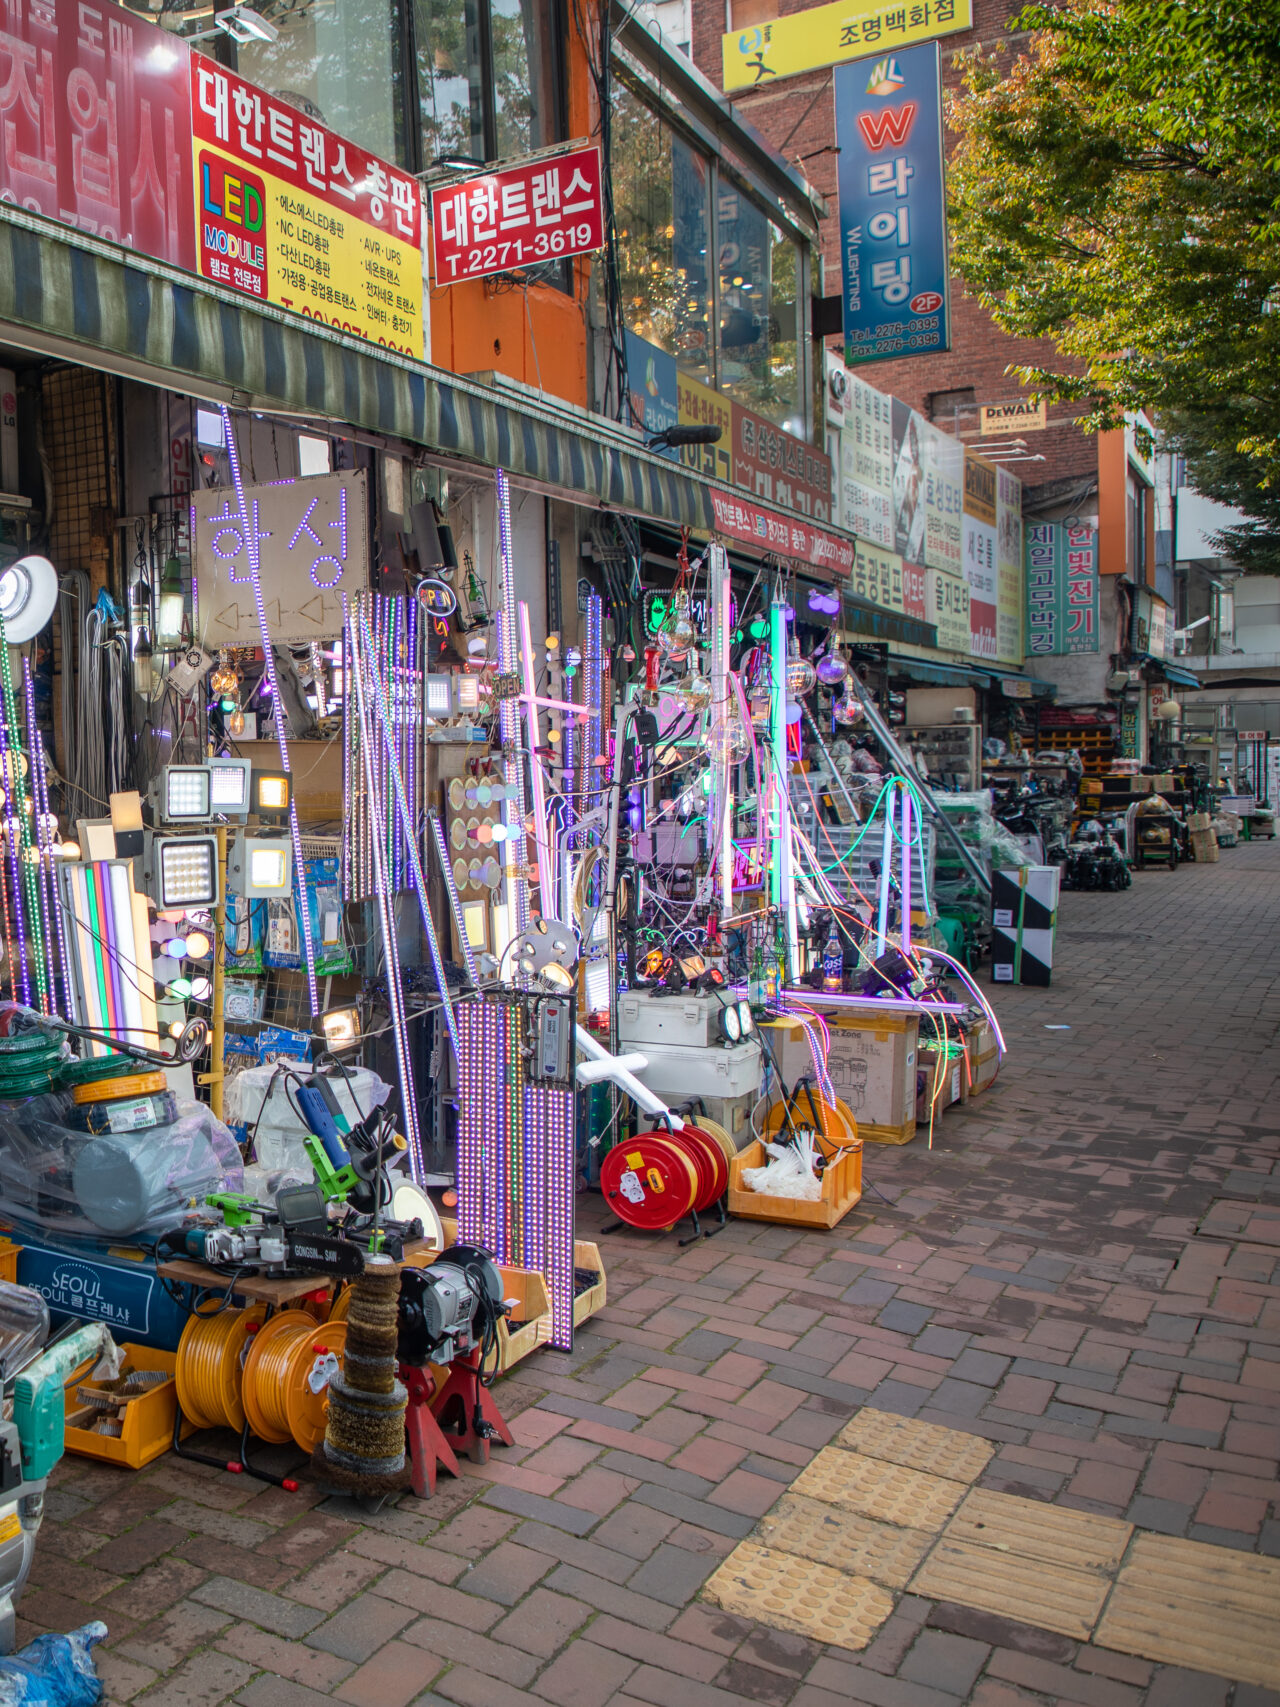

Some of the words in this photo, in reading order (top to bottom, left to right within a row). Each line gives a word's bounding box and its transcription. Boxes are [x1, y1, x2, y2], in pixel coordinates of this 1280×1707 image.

[839, 0, 955, 47] 조명백화점
[859, 104, 914, 147] W
[197, 66, 356, 202] 대한트랜스
[366, 160, 417, 238] 총판
[203, 162, 264, 233] LED
[440, 167, 595, 248] 대한트랜스
[205, 224, 265, 271] MODULE
[281, 220, 294, 237] NC
[297, 227, 329, 255] LED총판
[447, 222, 593, 275] T.2271-3619
[868, 157, 914, 305] 라이팅
[210, 257, 230, 280] 램프
[234, 266, 261, 294] 전문점
[280, 244, 330, 278] 다산LED총판
[365, 261, 401, 287] 네온트랜스
[847, 246, 861, 312] LIGHTING
[366, 282, 394, 306] 전자네온
[396, 293, 416, 315] 트랜스
[916, 296, 937, 312] 2F
[4, 416, 15, 427] LG
[986, 403, 1040, 418] DEWALT
[926, 472, 962, 517] 효성모터
[715, 499, 751, 531] 대한트랜스
[791, 528, 806, 551] 총판
[421, 589, 451, 607] OPEN
[855, 553, 902, 605] 동광펌프
[936, 576, 970, 619] 을지모터
[1029, 524, 1055, 652] 제일고무박킹
[841, 1029, 862, 1039] Zone
[294, 1245, 318, 1259] GONGSIN
[324, 1249, 338, 1263] SAW
[28, 1282, 69, 1305] SEOUL
[52, 1271, 104, 1300] SEOUL
